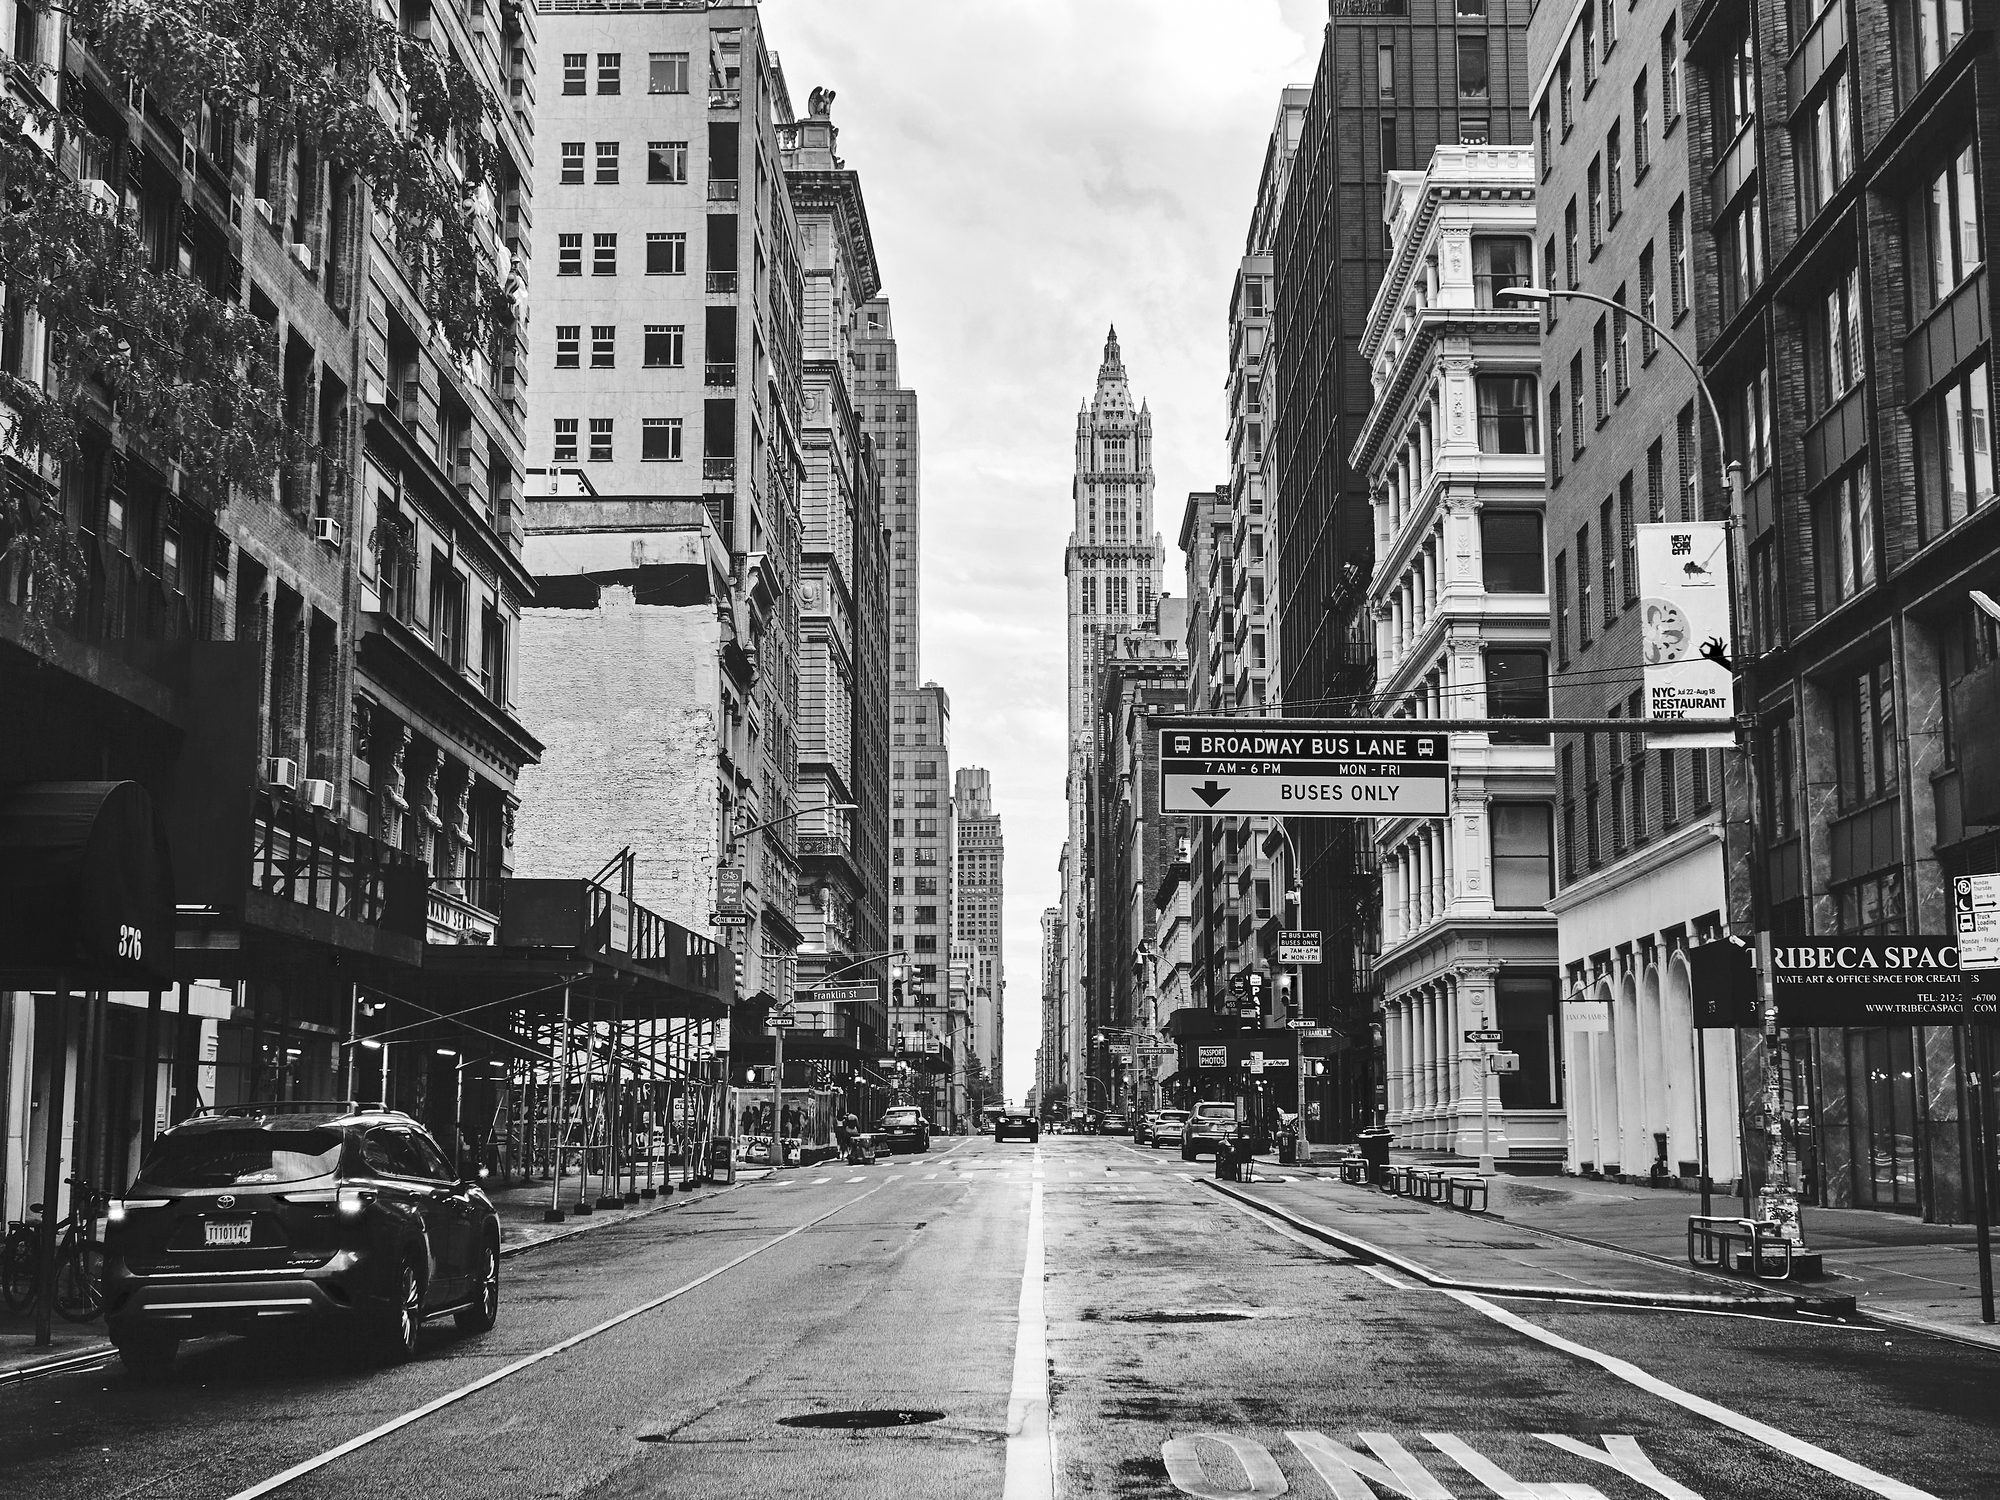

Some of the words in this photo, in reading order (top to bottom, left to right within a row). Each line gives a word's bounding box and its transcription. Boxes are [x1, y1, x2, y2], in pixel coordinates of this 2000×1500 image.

[1652, 687, 1676, 698] NYC
[1653, 698, 1726, 709] RESTAURANT
[1653, 710, 1685, 718] WEEK
[1201, 736, 1304, 755] BROADWAY
[1311, 738, 1349, 755] BUS
[1356, 739, 1407, 756] LANE
[1204, 763, 1212, 774] 7
[1217, 763, 1237, 774] AM
[1250, 763, 1257, 774] 6
[1263, 763, 1281, 774] PM
[1339, 764, 1368, 775] MON
[1380, 765, 1400, 775] FRI
[1281, 784, 1343, 800] BUSES
[1351, 785, 1400, 801] ONLY
[118, 924, 142, 961] 376
[1884, 946, 1958, 968] SPAC
[1776, 975, 1803, 983] IVATE
[1805, 975, 1824, 983] ART
[1826, 975, 1834, 983] &
[1836, 974, 1871, 983] OFFICE
[1873, 974, 1902, 983] SPACE
[1904, 974, 1924, 983] FOR
[1926, 974, 1980, 983] CREATIS
[813, 990, 846, 1000] Franklin
[849, 990, 857, 998] St
[1917, 993, 1938, 1002] TEL:
[1865, 1004, 1997, 1013] WWW.TRIBECASPAC.COM
[1200, 1048, 1225, 1057] PASSPORT
[1201, 1056, 1225, 1065] PHOTOS
[1162, 1431, 1702, 1500] ONLY
